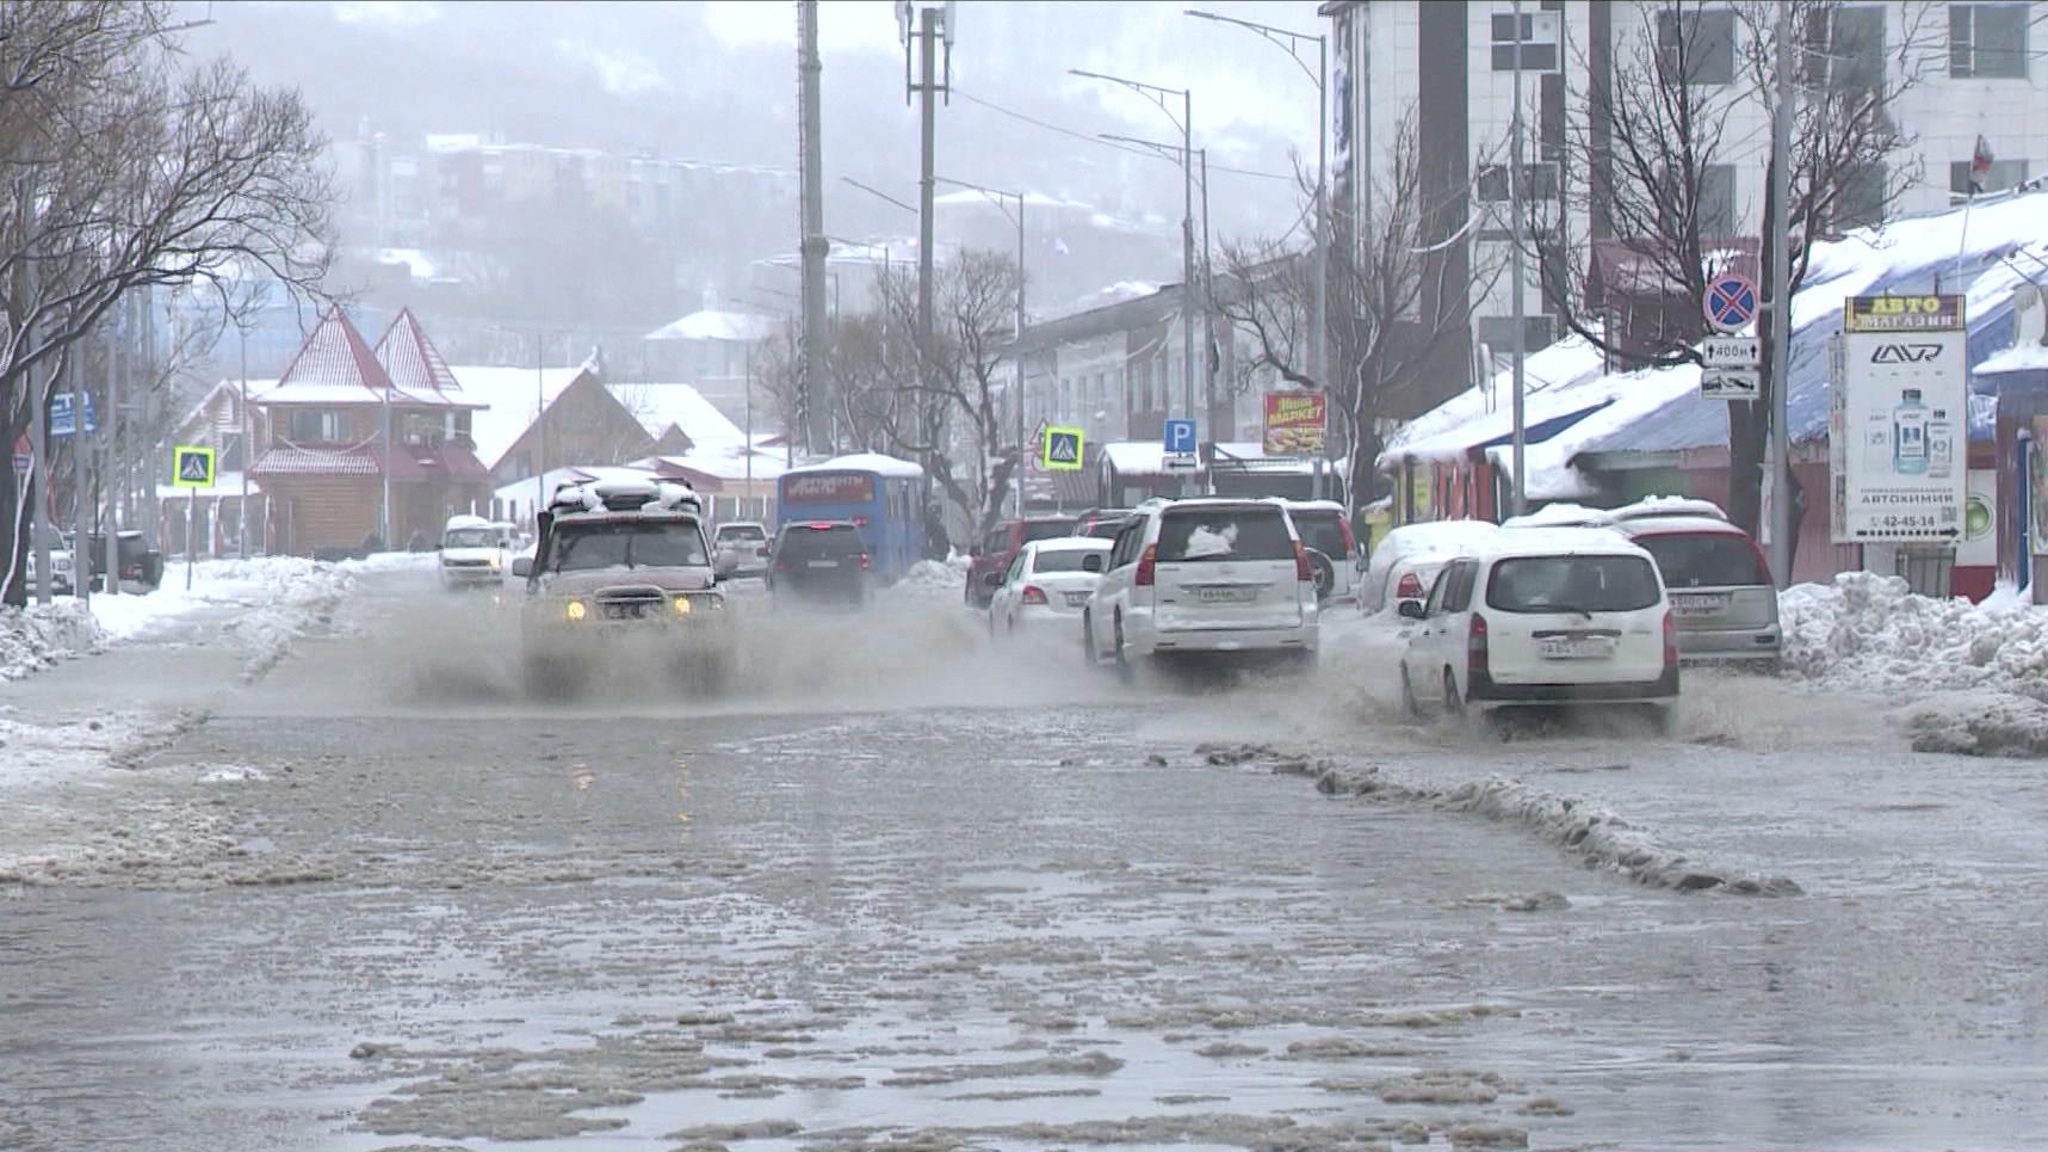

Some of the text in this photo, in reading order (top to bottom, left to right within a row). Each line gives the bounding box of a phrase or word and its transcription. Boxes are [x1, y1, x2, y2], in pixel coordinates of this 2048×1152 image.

[1872, 298, 1939, 313] АВТО
[1174, 423, 1191, 450] P
[1861, 494, 1954, 504] АВТОХИМИЯ
[1883, 515, 1934, 527] 42-45-14
